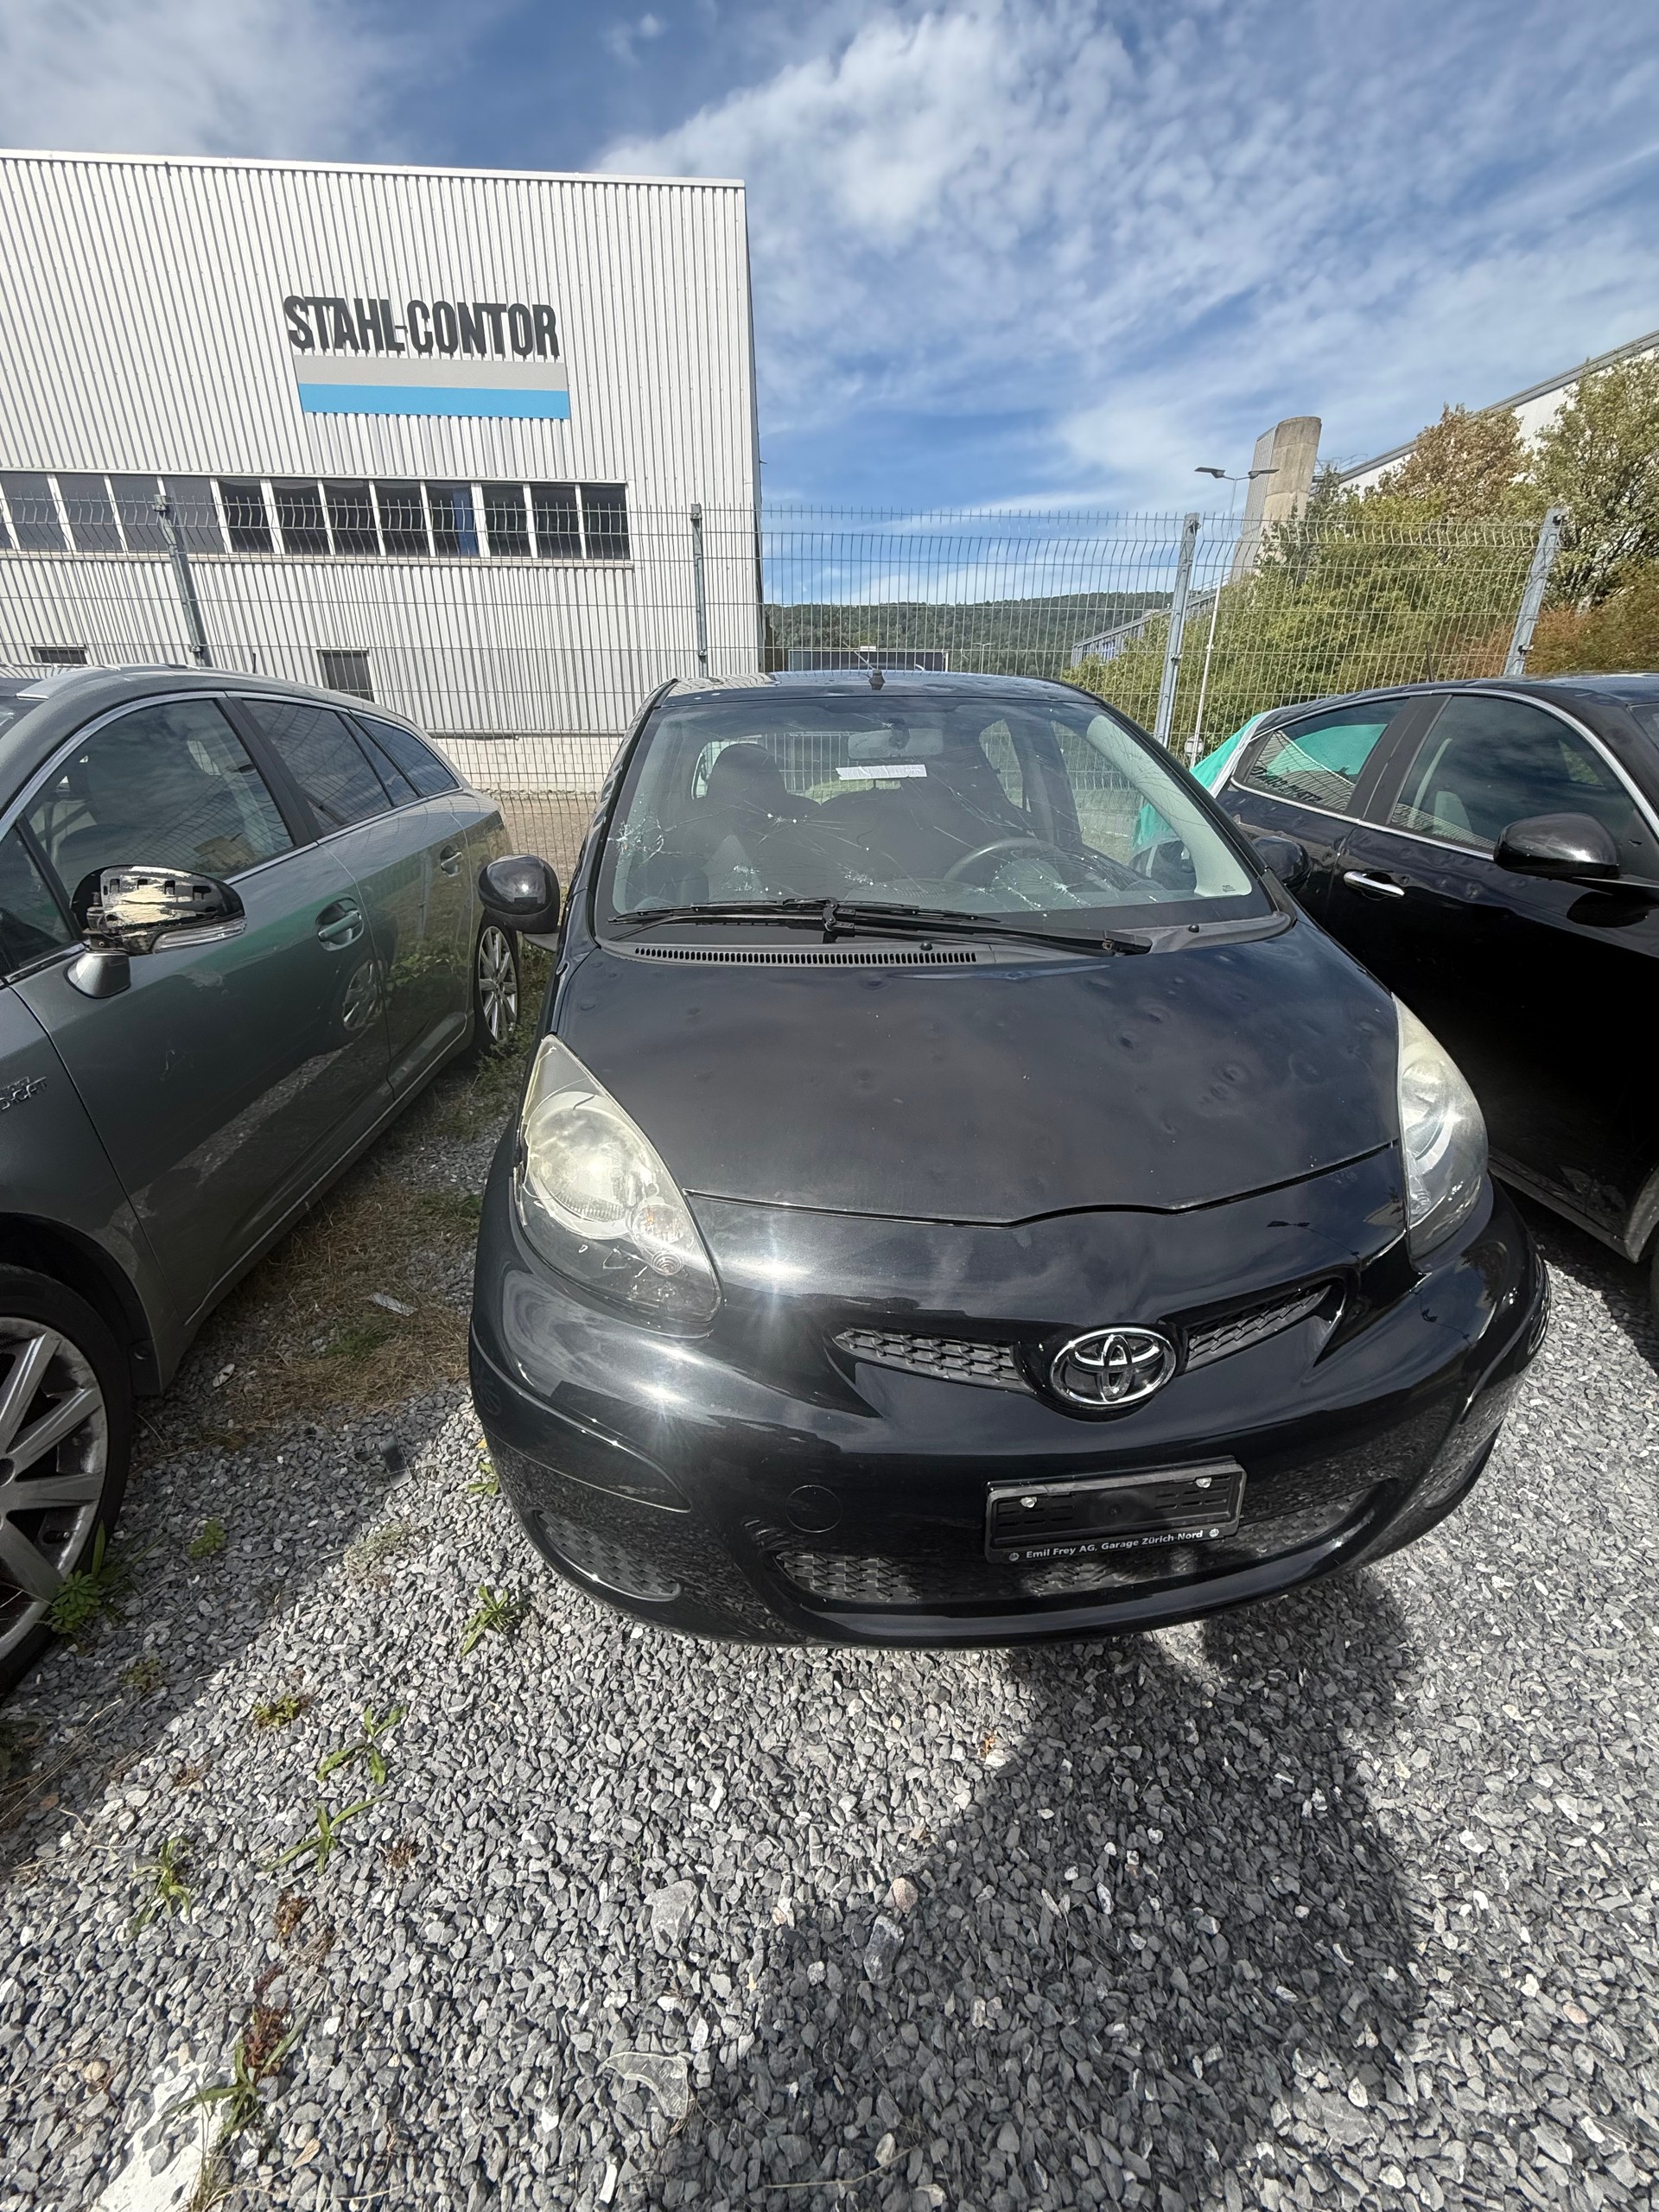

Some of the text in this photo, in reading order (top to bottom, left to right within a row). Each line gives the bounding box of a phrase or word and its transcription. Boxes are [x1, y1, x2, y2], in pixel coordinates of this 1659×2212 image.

[283, 295, 561, 357] STAHL-CONTOR
[1026, 1548, 1051, 1559] Emil
[1052, 1547, 1077, 1556] Frey
[1078, 1543, 1098, 1553] AG,
[1101, 1540, 1140, 1550] Garage
